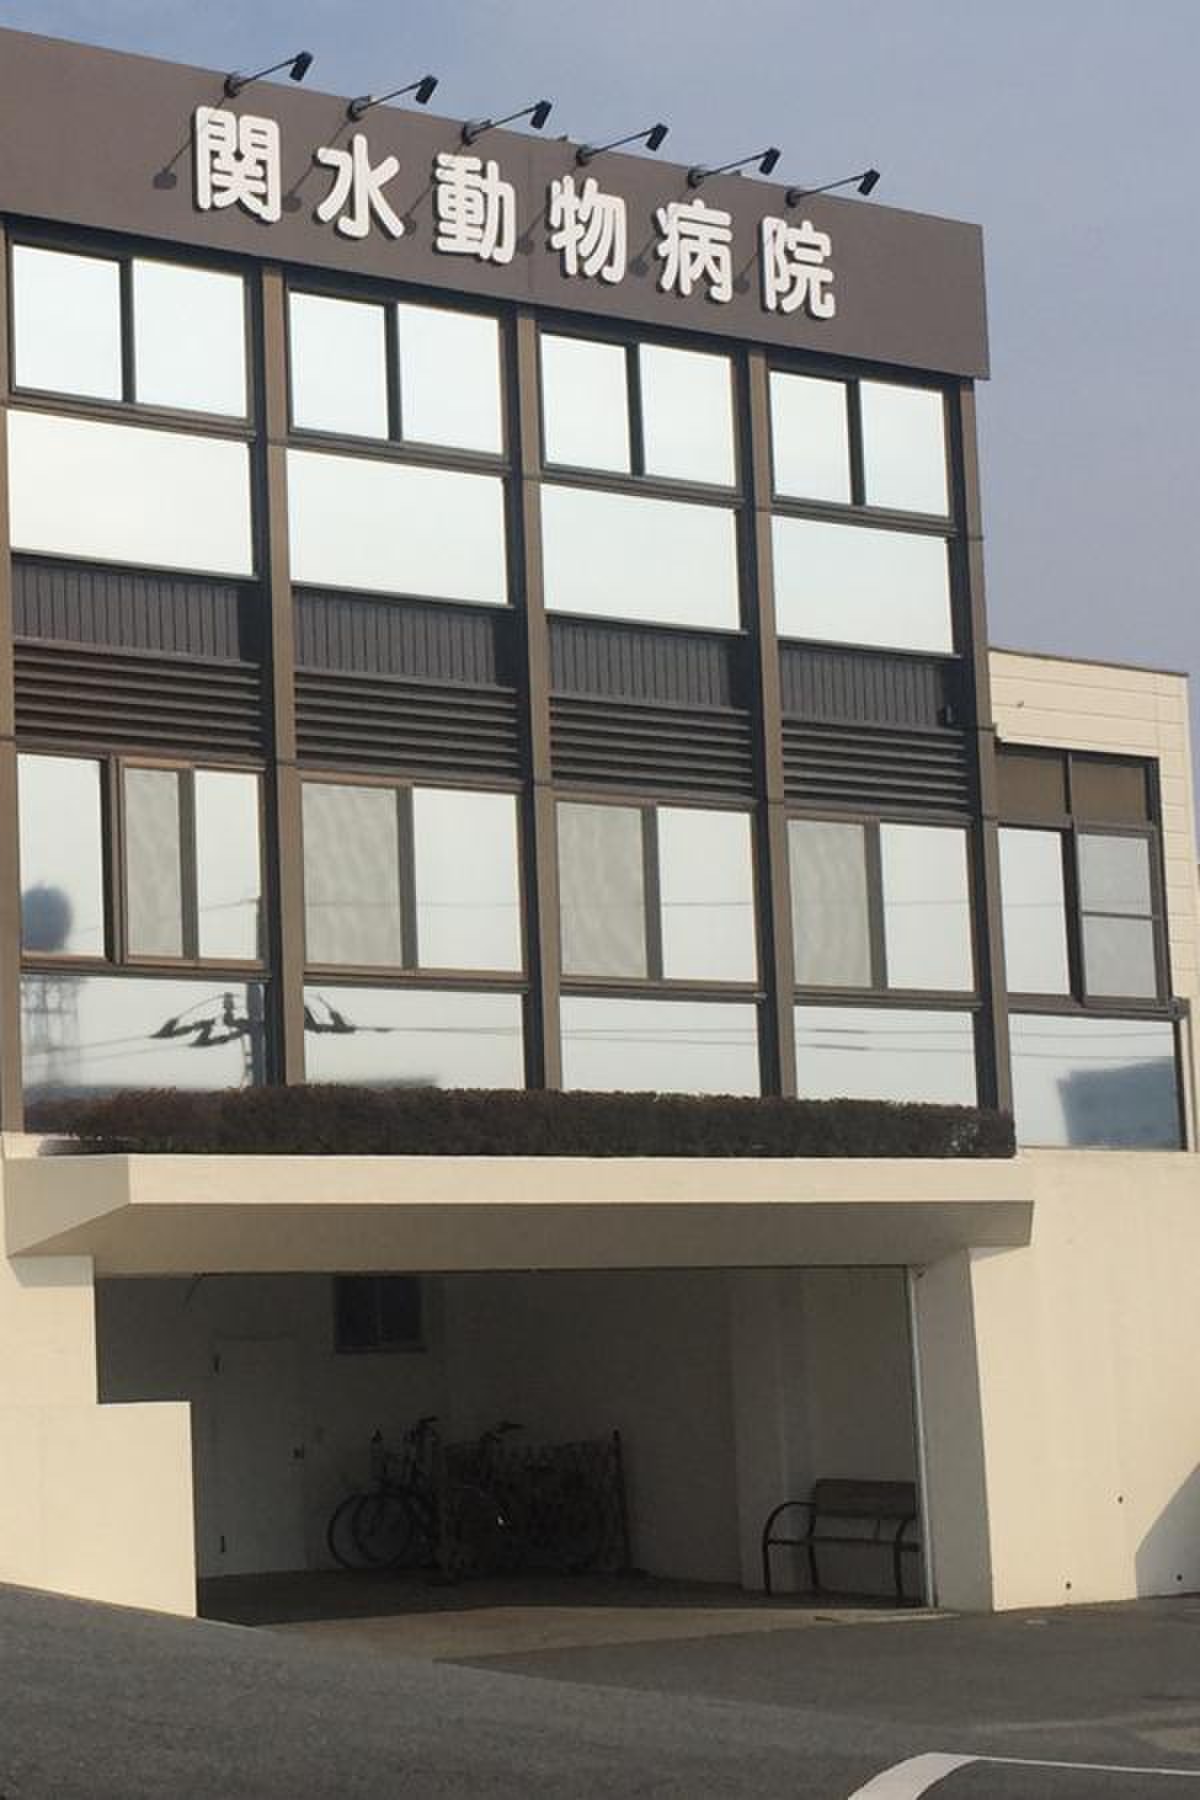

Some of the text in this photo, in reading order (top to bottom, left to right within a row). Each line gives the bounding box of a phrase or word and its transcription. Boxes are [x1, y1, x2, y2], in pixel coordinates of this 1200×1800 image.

[194, 106, 836, 319] 関水動物病院
